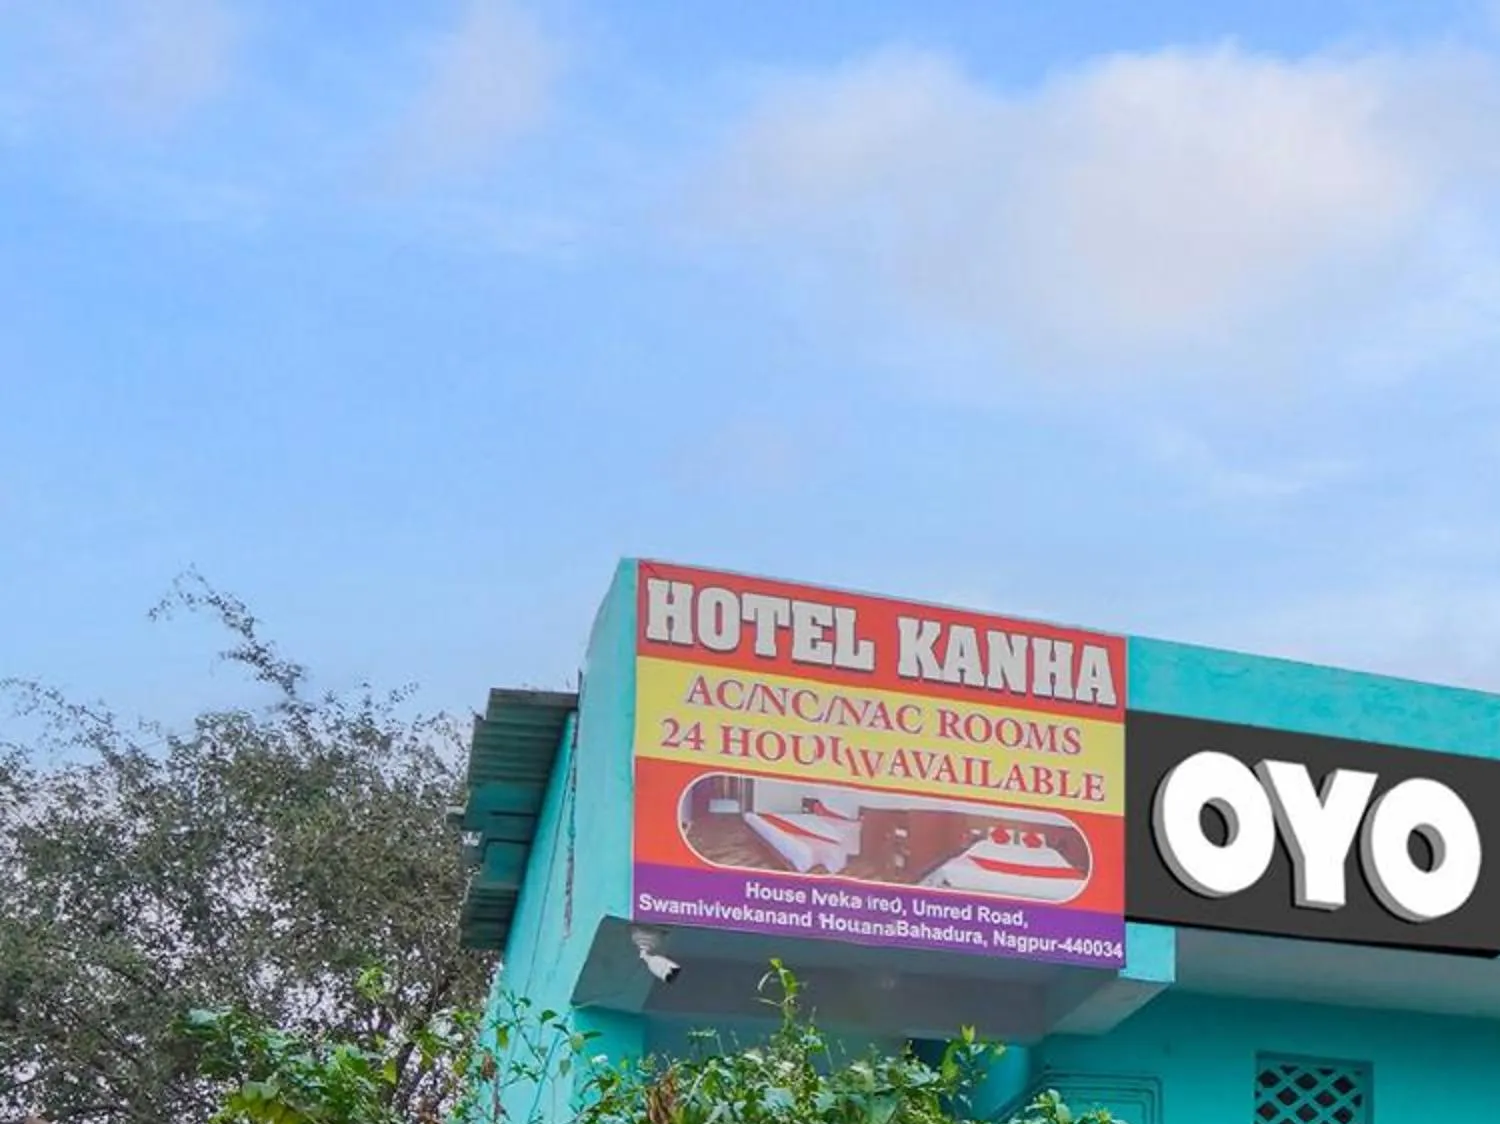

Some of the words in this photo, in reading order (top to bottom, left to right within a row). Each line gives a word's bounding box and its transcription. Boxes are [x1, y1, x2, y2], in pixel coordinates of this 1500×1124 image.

[646, 576, 876, 673] HOTEL
[896, 615, 1117, 707] KANHA
[660, 717, 706, 751] 24
[937, 707, 1083, 756] ROOMS
[1151, 750, 1482, 923] OYO
[638, 893, 812, 928] Swamivivekanand
[992, 931, 1124, 959] Nagpur-440034
[745, 881, 807, 904] House
[912, 899, 972, 921] Umred
[977, 906, 1029, 927] Road,
